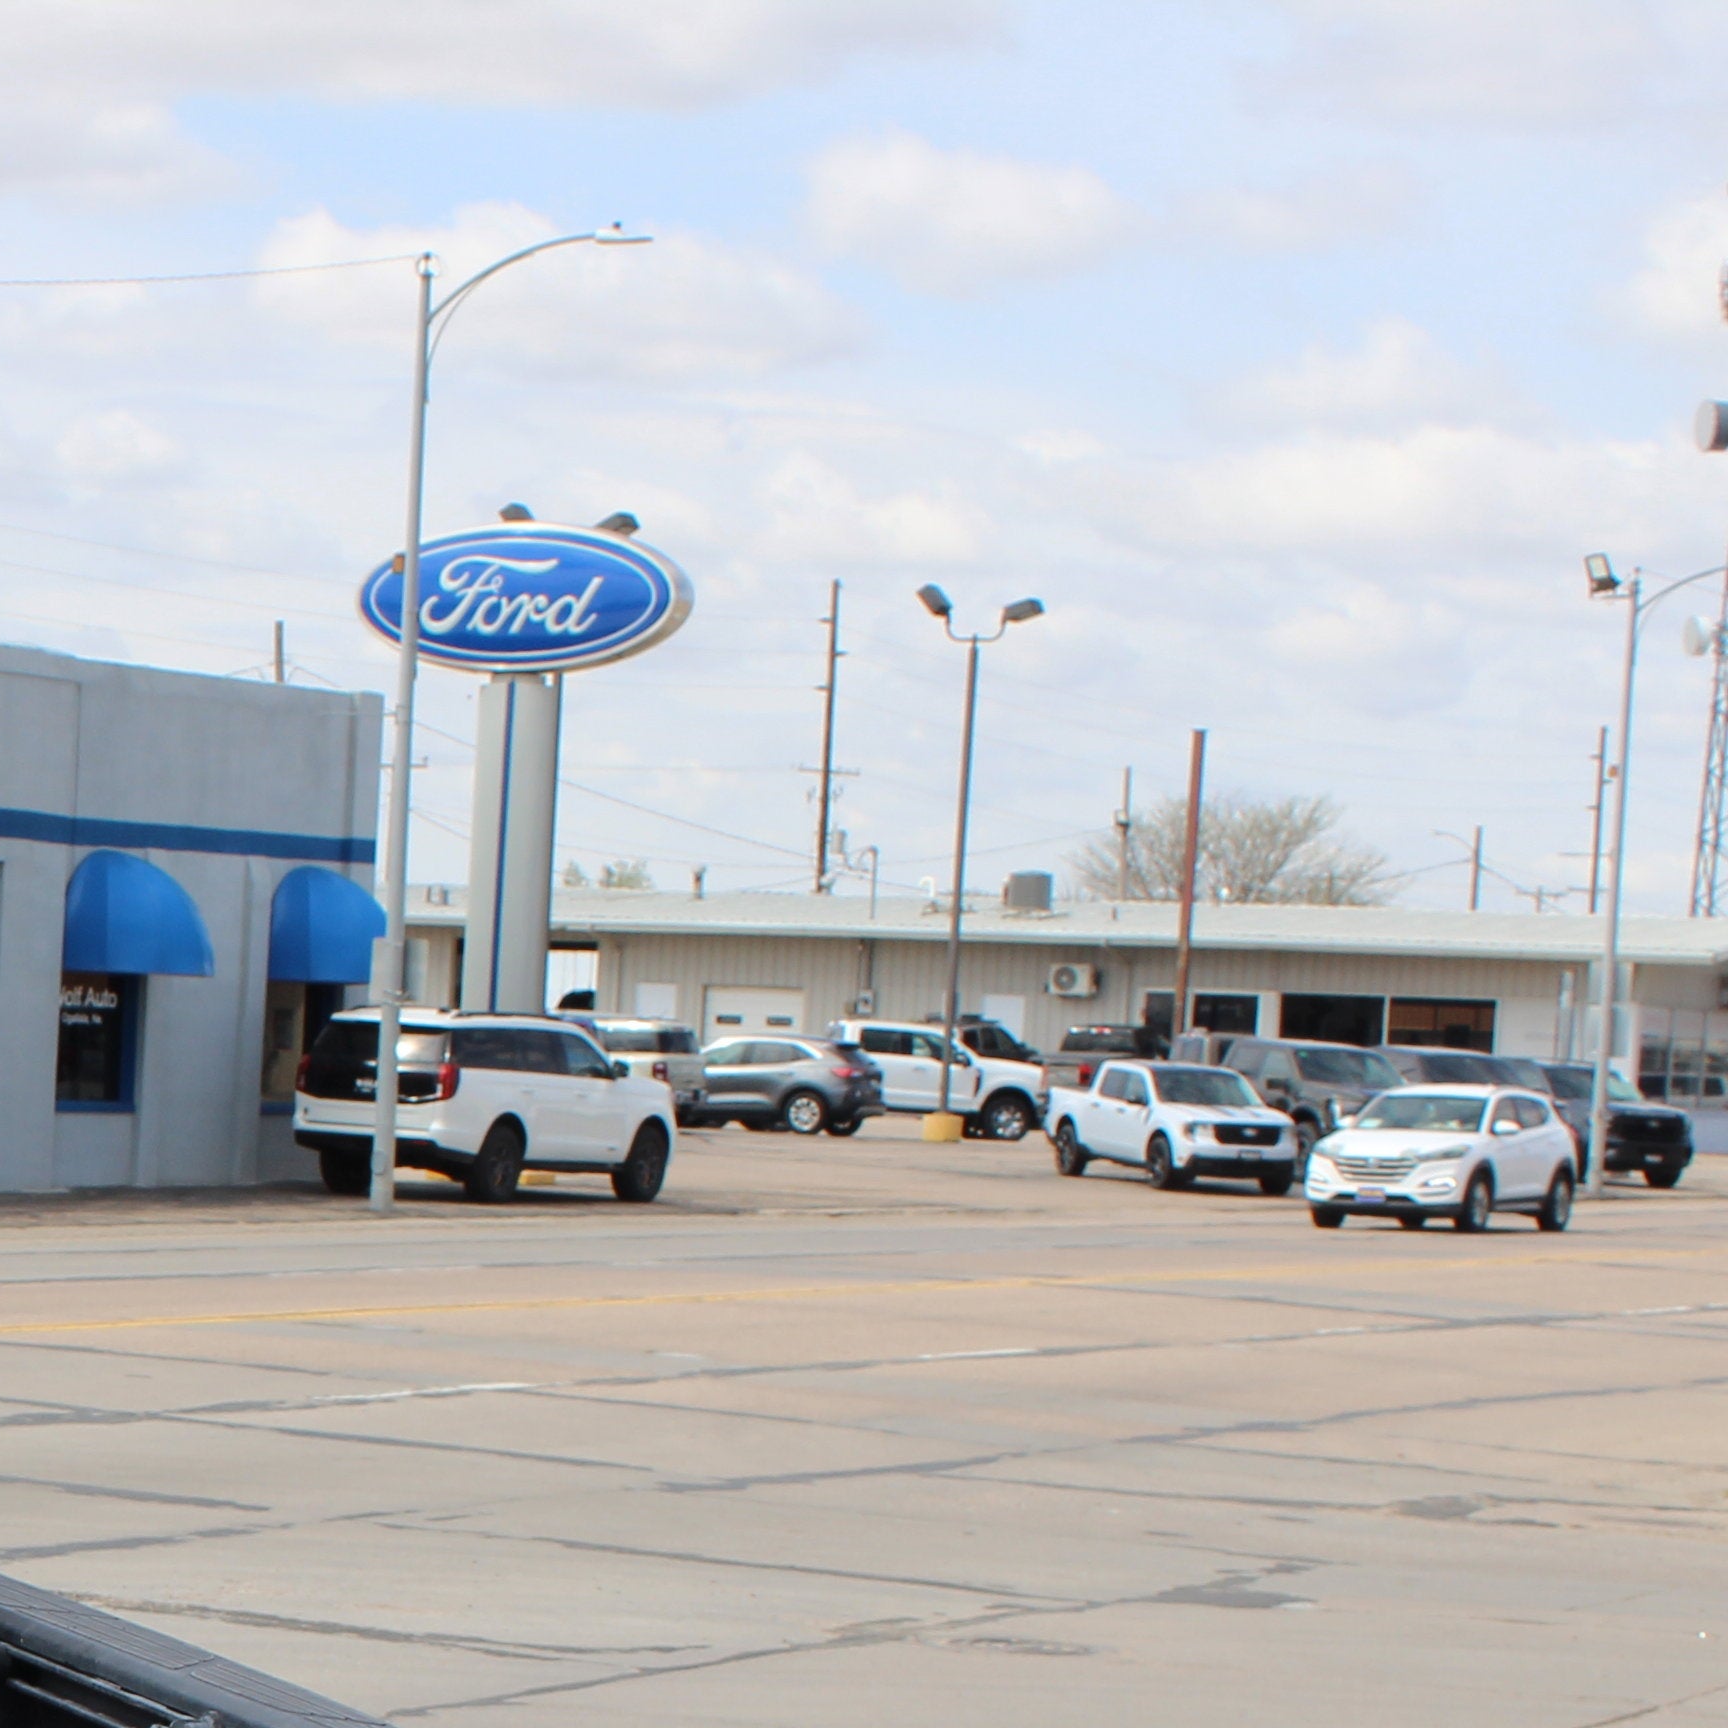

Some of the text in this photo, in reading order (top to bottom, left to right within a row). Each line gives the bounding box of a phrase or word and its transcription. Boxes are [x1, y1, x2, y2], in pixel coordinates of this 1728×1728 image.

[419, 554, 604, 635] Ford
[59, 986, 119, 1009] olf Auto
